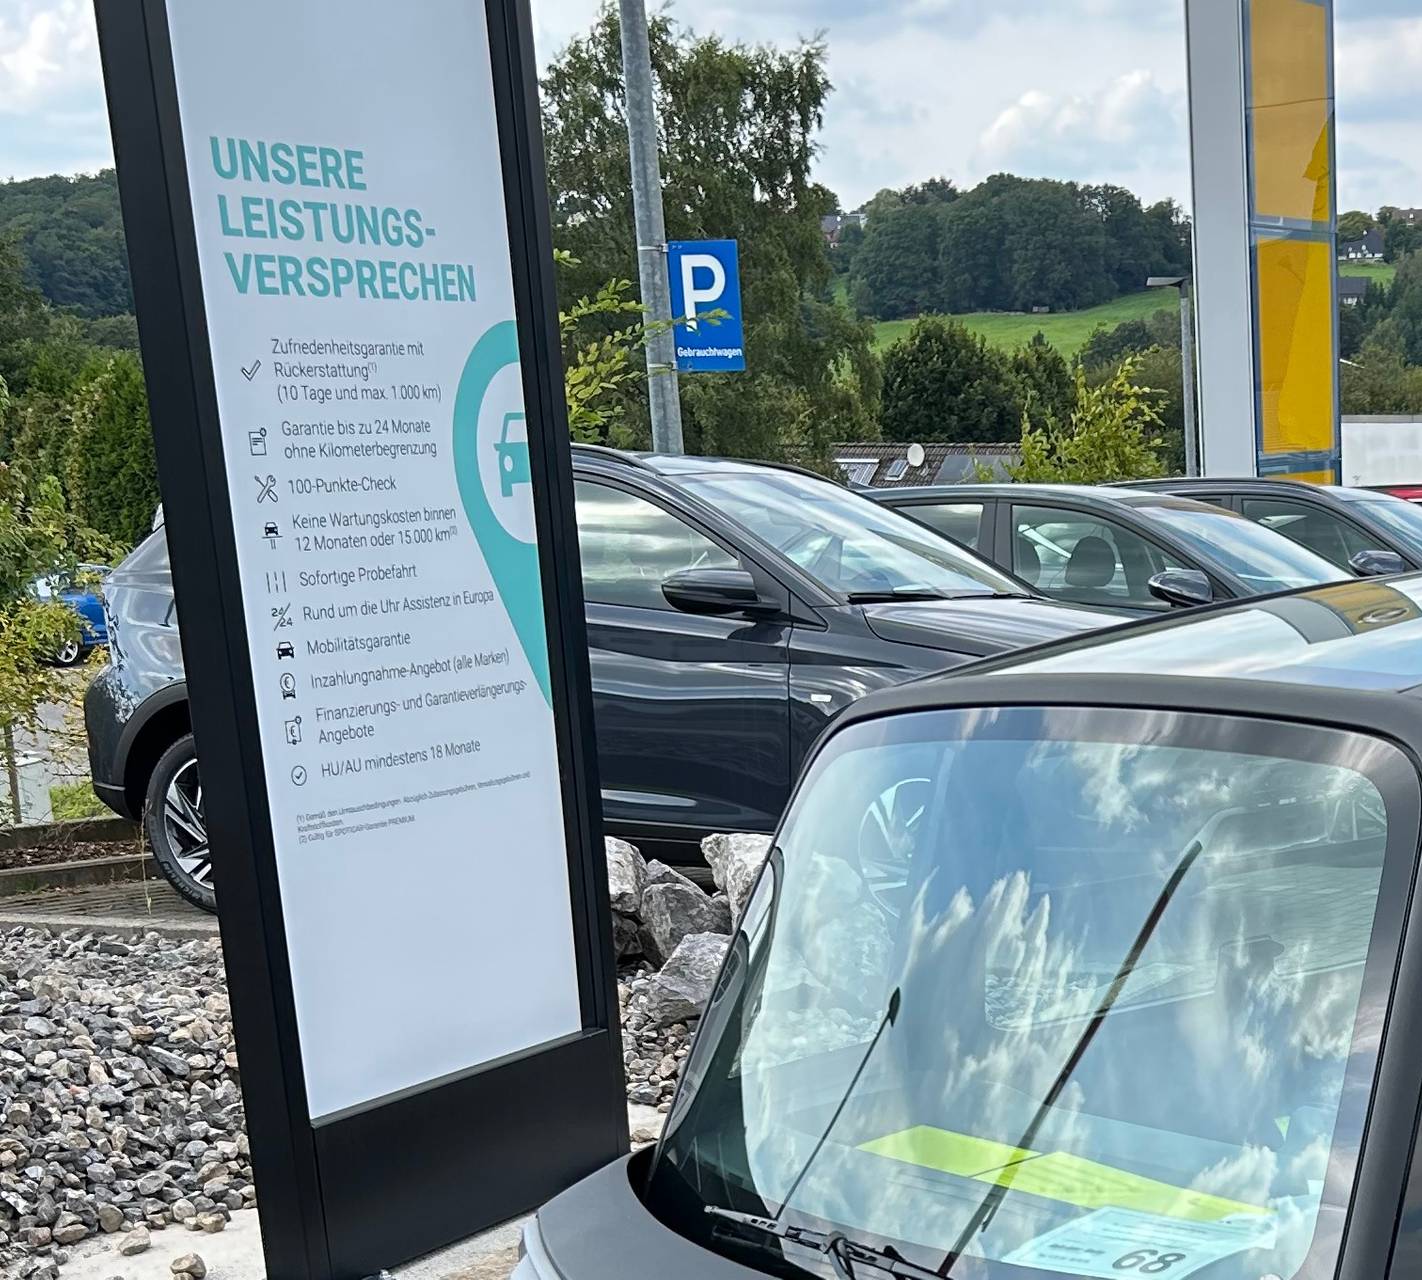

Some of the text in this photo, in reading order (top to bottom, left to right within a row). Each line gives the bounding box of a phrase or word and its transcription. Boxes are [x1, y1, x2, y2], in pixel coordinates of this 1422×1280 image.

[209, 136, 367, 190] UNSERE
[217, 194, 436, 248] LEISTUNGS-
[223, 252, 477, 302] VERSPRECHEN
[681, 254, 726, 332] P
[271, 338, 424, 359] Zufriedenheitsgarantie mit
[677, 347, 743, 358] Gebrauchtwagen
[277, 384, 442, 404] (10 Tage und max. 1.000 km)
[281, 419, 431, 436] Garantie bis zu 24 Monate
[284, 442, 437, 460] ohne Kilometerbegrenzung
[288, 475, 397, 494] 100-Punkte-Check
[292, 506, 457, 531] Keine Wartungskosten binnen
[295, 536, 311, 552] 12
[315, 534, 368, 550] Monaten
[371, 531, 395, 548] oder
[398, 529, 433, 546] 15.000
[299, 564, 418, 587] Sofortige Probefahrt
[303, 589, 494, 621] Rund um die Uhr Assistenz in Europa
[306, 632, 412, 655] Mobilitätsgarantie
[311, 648, 511, 689] Inzahlungnahme-Angebot (alle Marken)
[315, 679, 527, 722] Finanzierungs- und Garantieverlängerungs-
[318, 724, 375, 745] Angebote
[321, 739, 481, 778] HU/AU mindestens 18 Monate
[1111, 1248, 1187, 1275] 68
